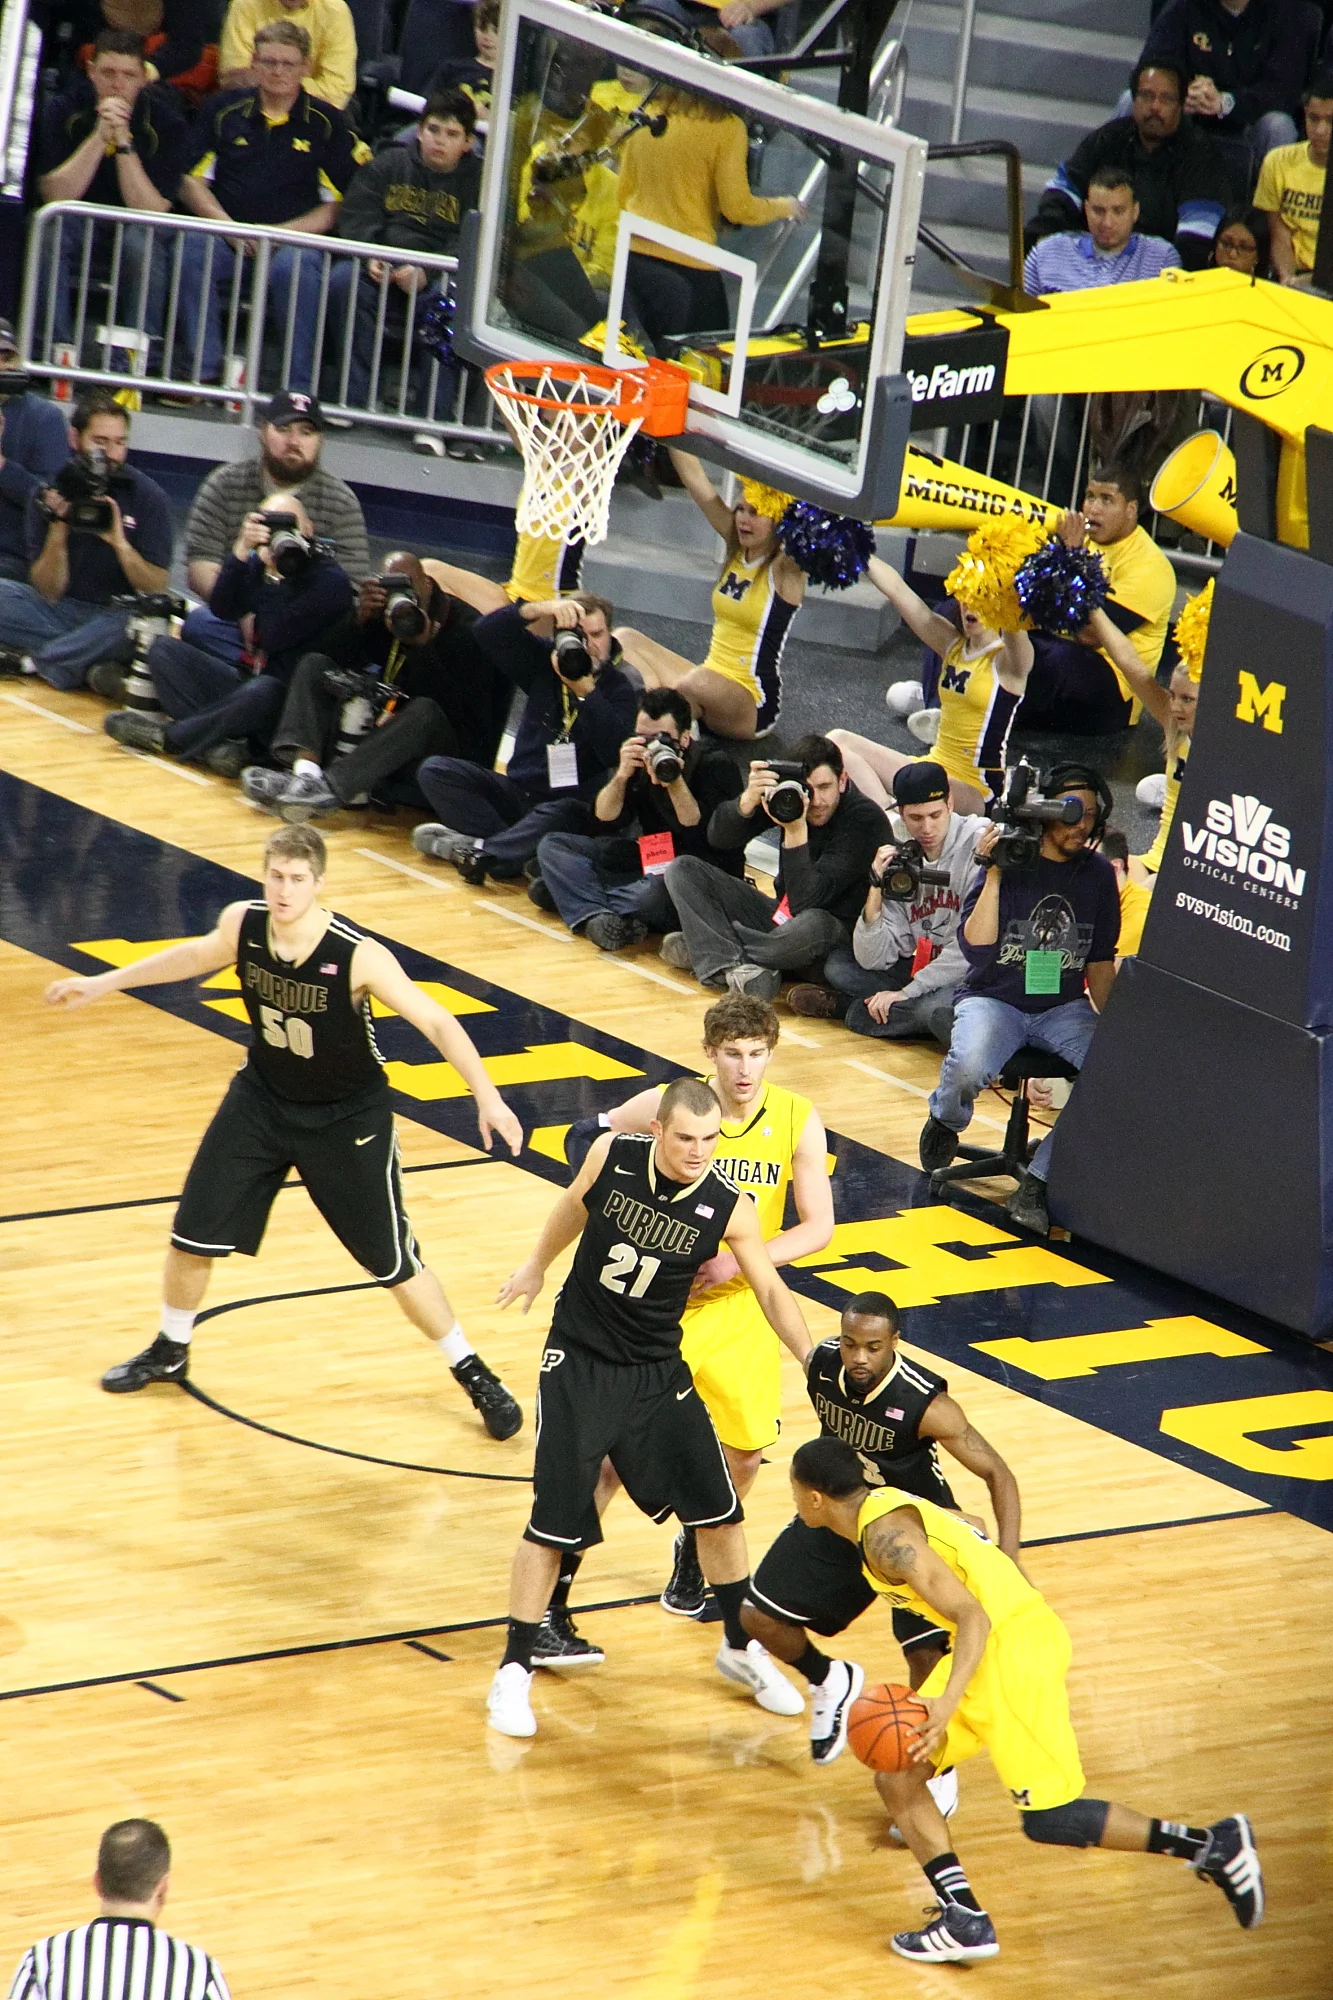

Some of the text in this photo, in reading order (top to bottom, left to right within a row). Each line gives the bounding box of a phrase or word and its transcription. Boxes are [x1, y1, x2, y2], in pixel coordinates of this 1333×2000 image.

[1261, 362, 1285, 383] M
[289, 391, 312, 412] T
[904, 474, 1049, 527] MICHIGAN
[719, 570, 752, 601] M
[941, 664, 972, 695] M
[1235, 669, 1287, 735] M
[1206, 793, 1291, 859] SVS
[646, 849, 668, 860] photo
[1182, 821, 1306, 897] VISION
[1183, 856, 1300, 910] OPTICAL CENTERS
[1175, 891, 1292, 952] svsvision.com
[244, 961, 329, 1013] PURDUE
[260, 1004, 314, 1059] 50
[602, 1189, 700, 1255] PURDUE
[599, 1242, 661, 1298] 21
[540, 1348, 565, 1372] P
[816, 1391, 895, 1453] PURDUE
